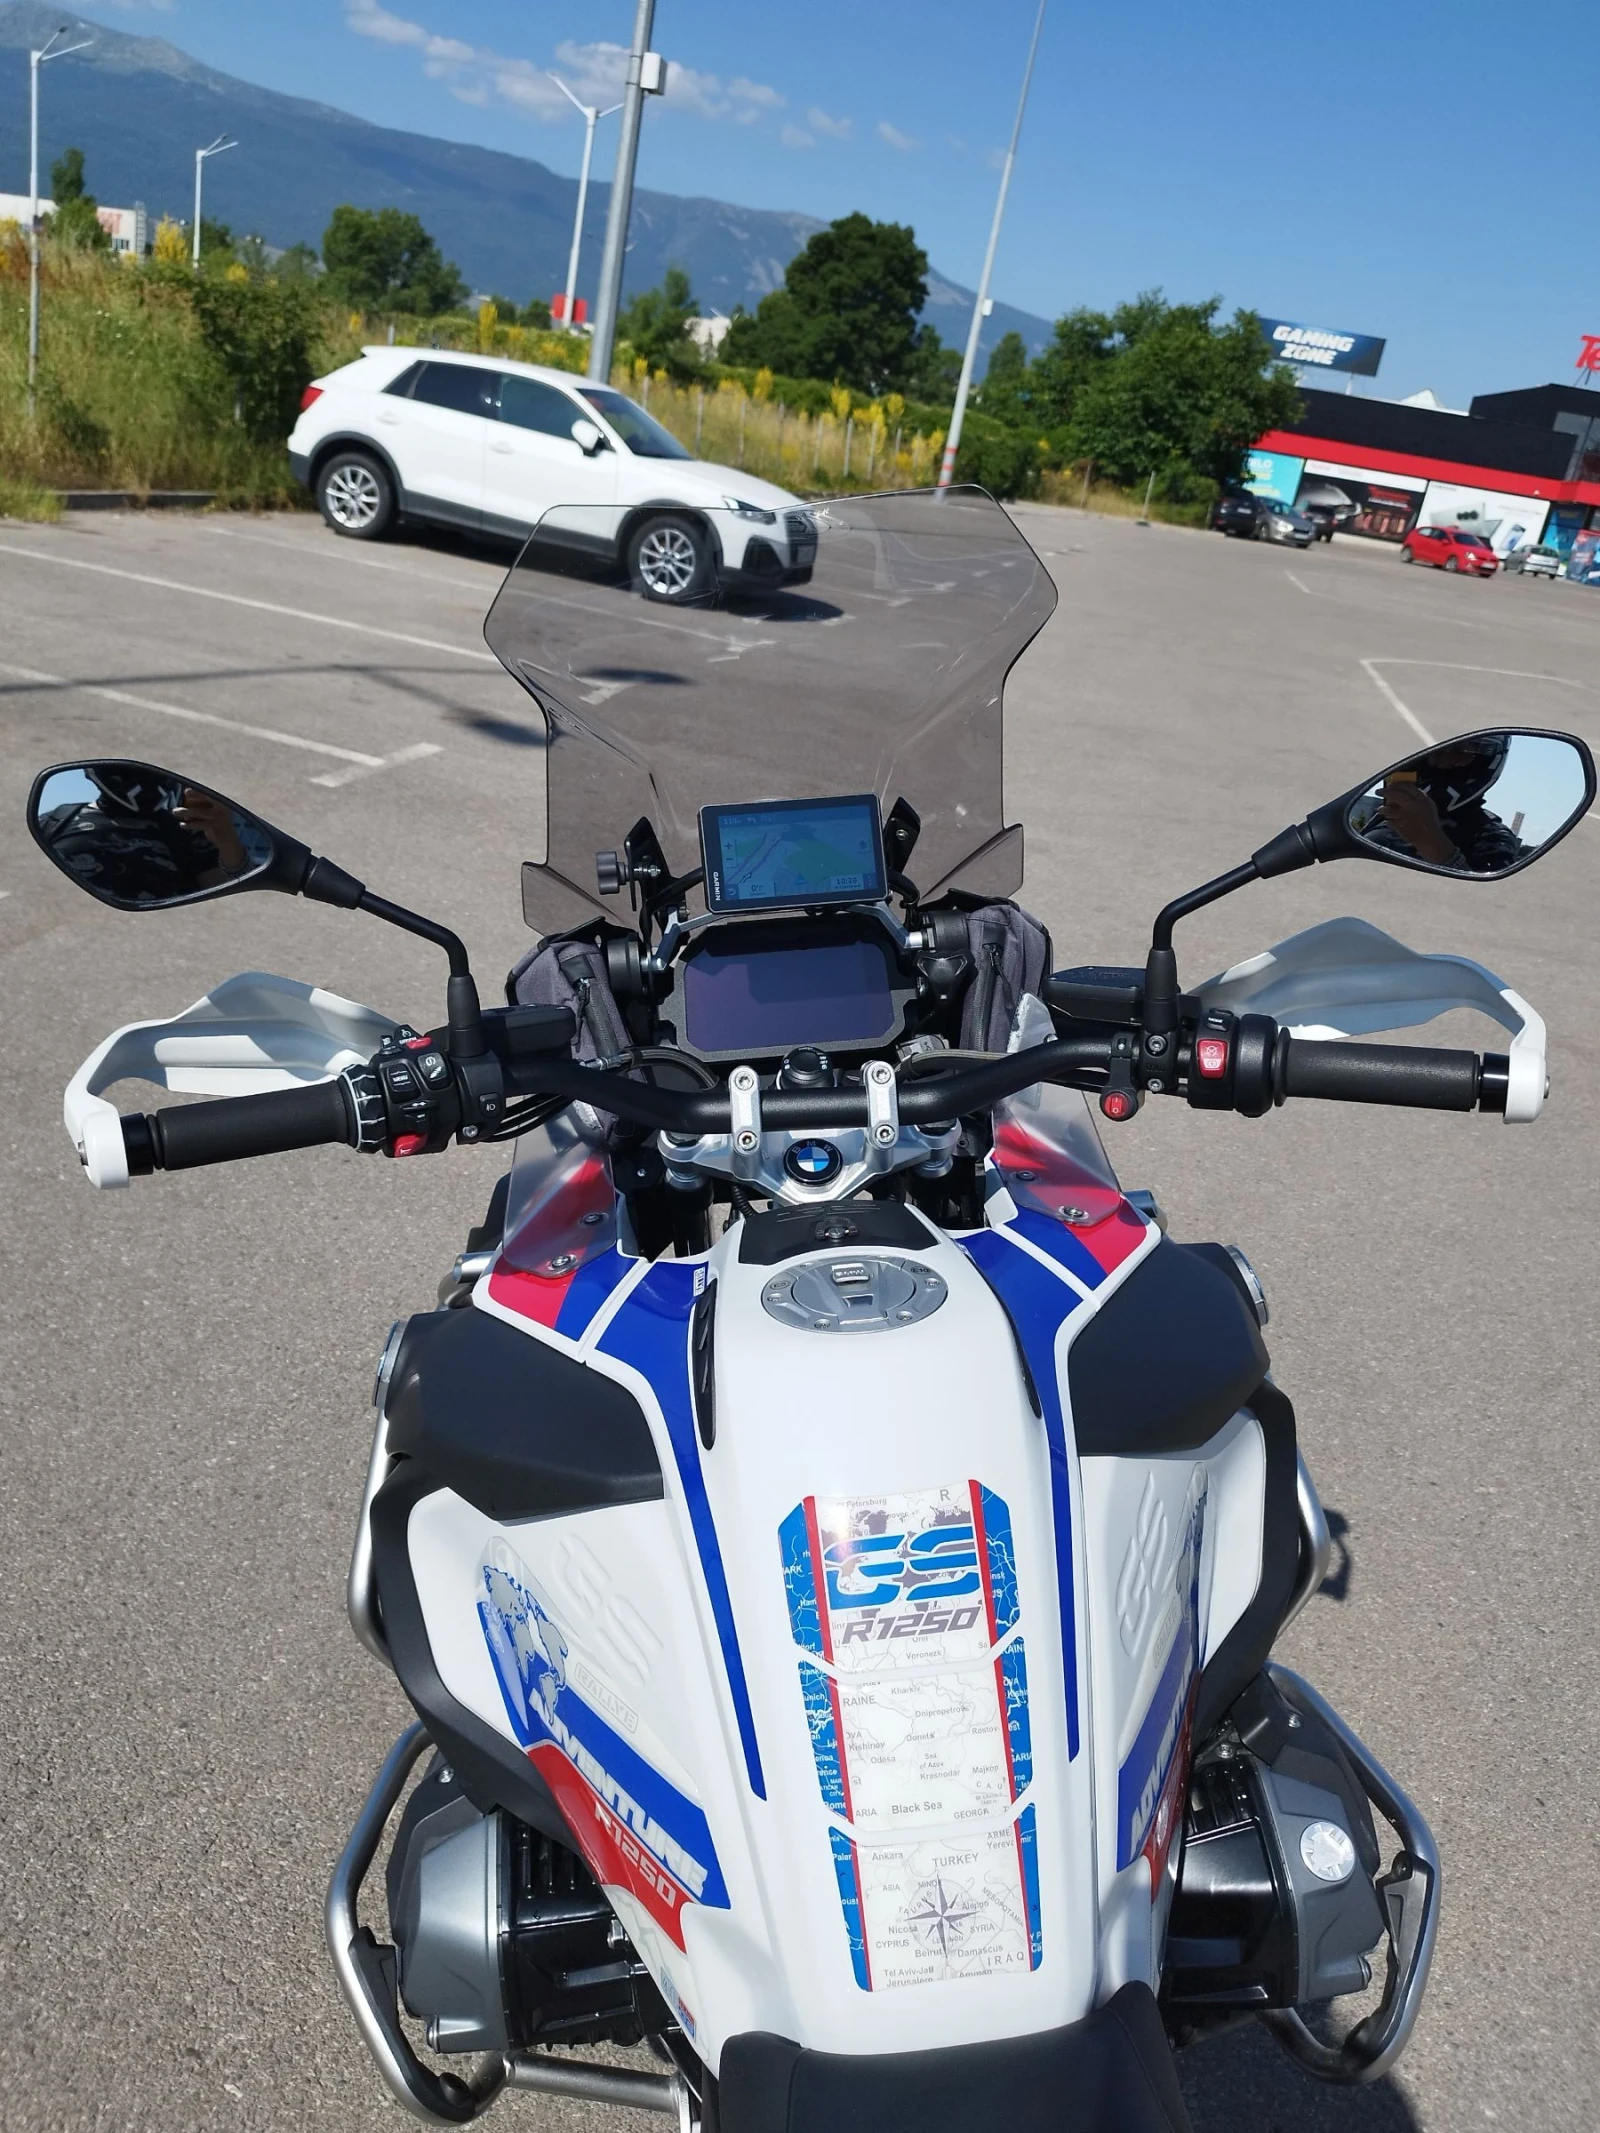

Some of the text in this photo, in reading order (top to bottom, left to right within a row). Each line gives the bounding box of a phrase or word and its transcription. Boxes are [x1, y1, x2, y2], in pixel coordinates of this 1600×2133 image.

[1272, 325, 1355, 352] GAMING
[1279, 343, 1337, 365] ZONE
[712, 871, 721, 901] GARMIN
[792, 1140, 833, 1154] BMW
[841, 1607, 982, 1646] R1250
[843, 1695, 876, 1707] RAINE
[920, 1769, 961, 1781] Krasnodar
[855, 1807, 878, 1818] ARIA
[891, 1801, 943, 1815] Black Sea
[871, 1852, 904, 1862] Ankara
[932, 1852, 980, 1868] TURKEY
[882, 1883, 901, 1892] ASIA
[969, 1923, 996, 1935] SYRIA
[875, 1939, 910, 1950] CYPRUS
[915, 1947, 944, 1959] Beirut
[957, 1945, 1004, 1958] Damascus
